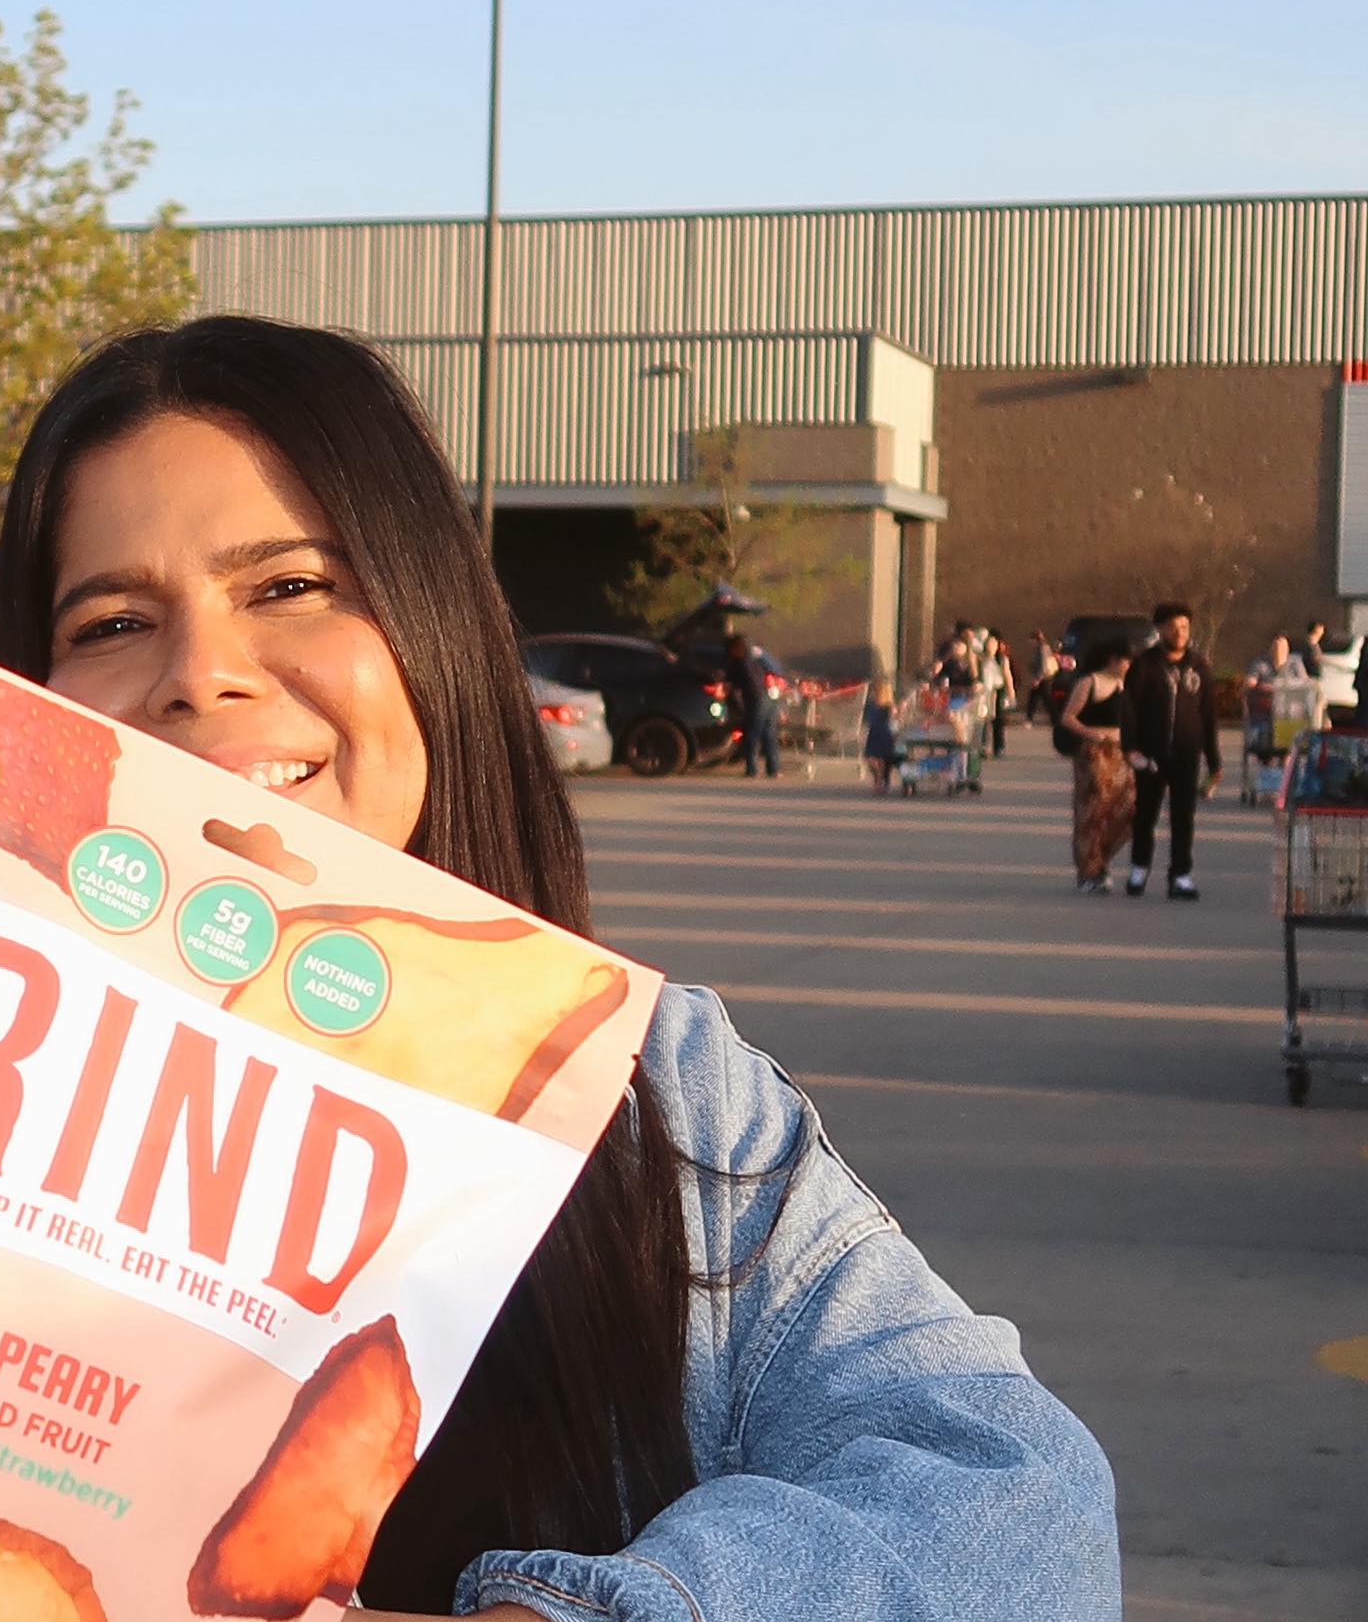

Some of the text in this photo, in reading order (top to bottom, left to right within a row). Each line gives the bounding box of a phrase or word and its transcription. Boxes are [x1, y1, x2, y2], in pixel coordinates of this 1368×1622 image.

[96, 845, 148, 884] 140
[76, 866, 151, 911] CALORIES
[78, 883, 142, 921] PER SERVING
[213, 899, 253, 935] 5g
[186, 934, 250, 972] PER SERVING
[199, 923, 247, 956] FIBER
[303, 954, 377, 997] NOTHING
[303, 979, 360, 1013] ADDED
[14, 1202, 43, 1233] IT
[47, 1213, 110, 1264] REAL.
[120, 1246, 170, 1283] EAT
[178, 1265, 223, 1307] THE
[22, 1412, 112, 1465] FRUIT
